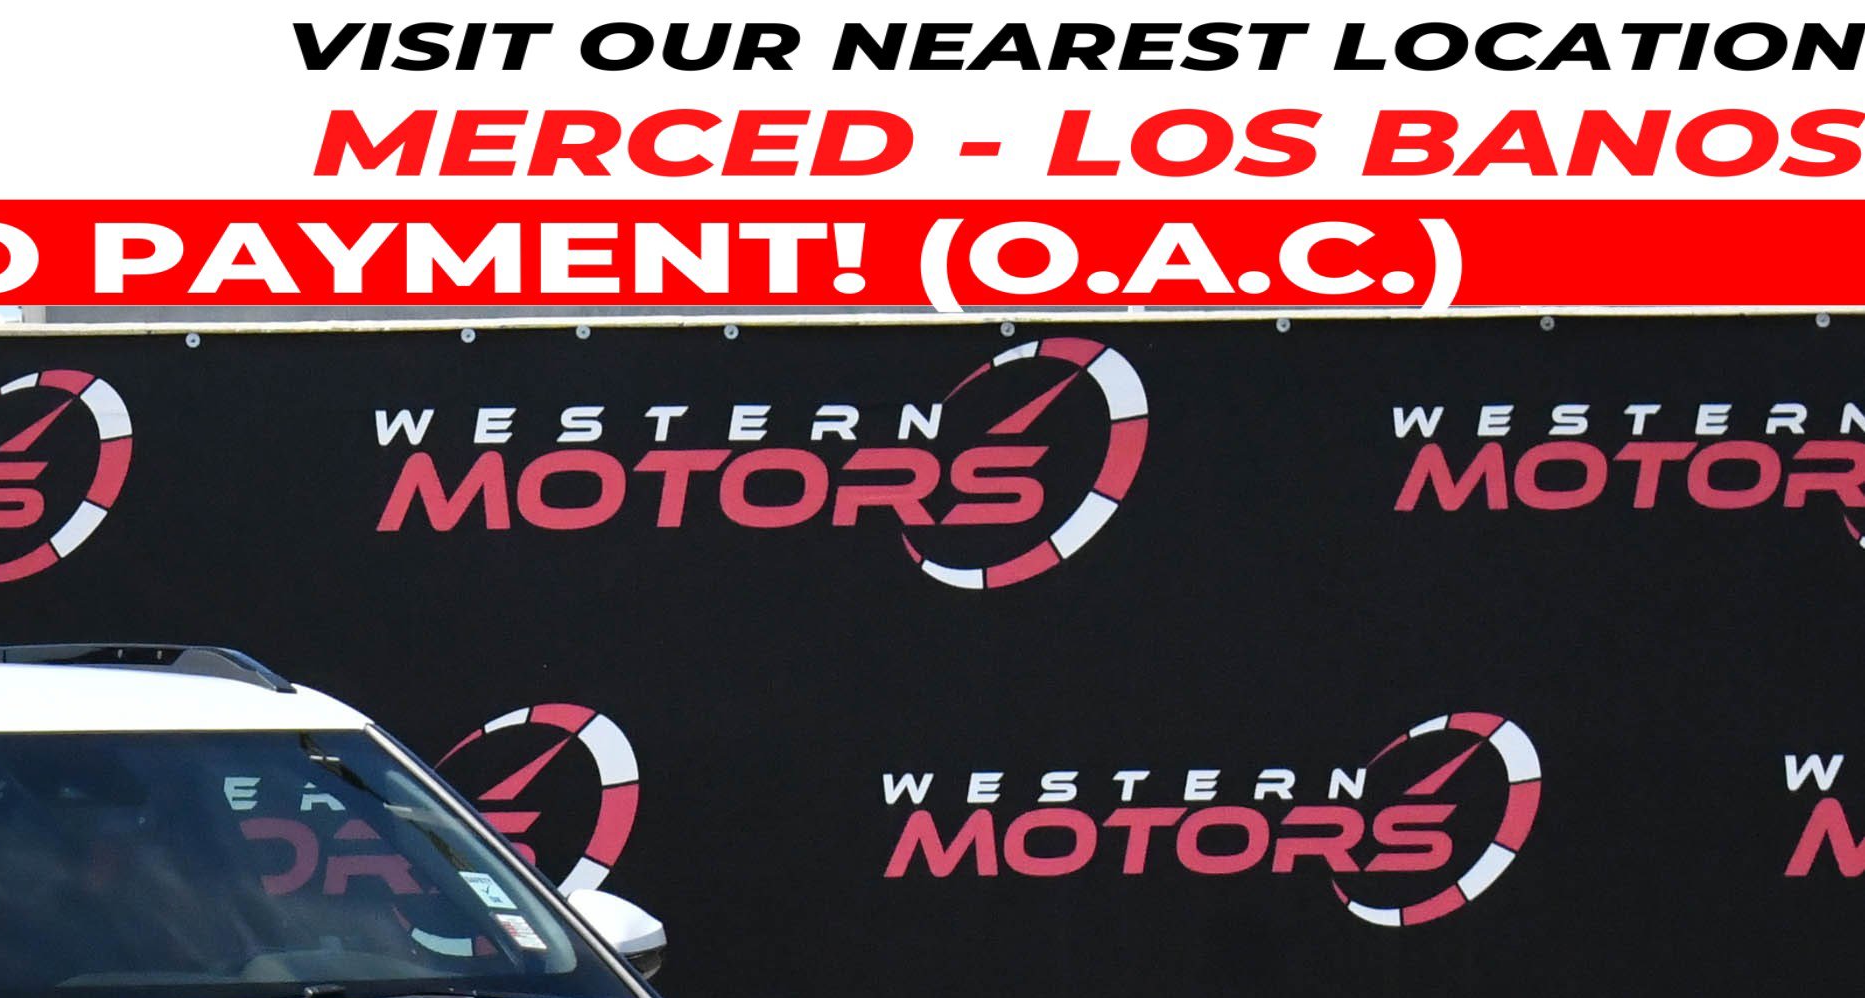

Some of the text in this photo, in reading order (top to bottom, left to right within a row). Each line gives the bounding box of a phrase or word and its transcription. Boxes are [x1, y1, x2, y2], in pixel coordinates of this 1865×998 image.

[376, 403, 942, 446] WESTERN
[376, 446, 1048, 532] MOTORS
[882, 768, 1367, 805] WESTERN
[883, 804, 1459, 878] MOTORS
